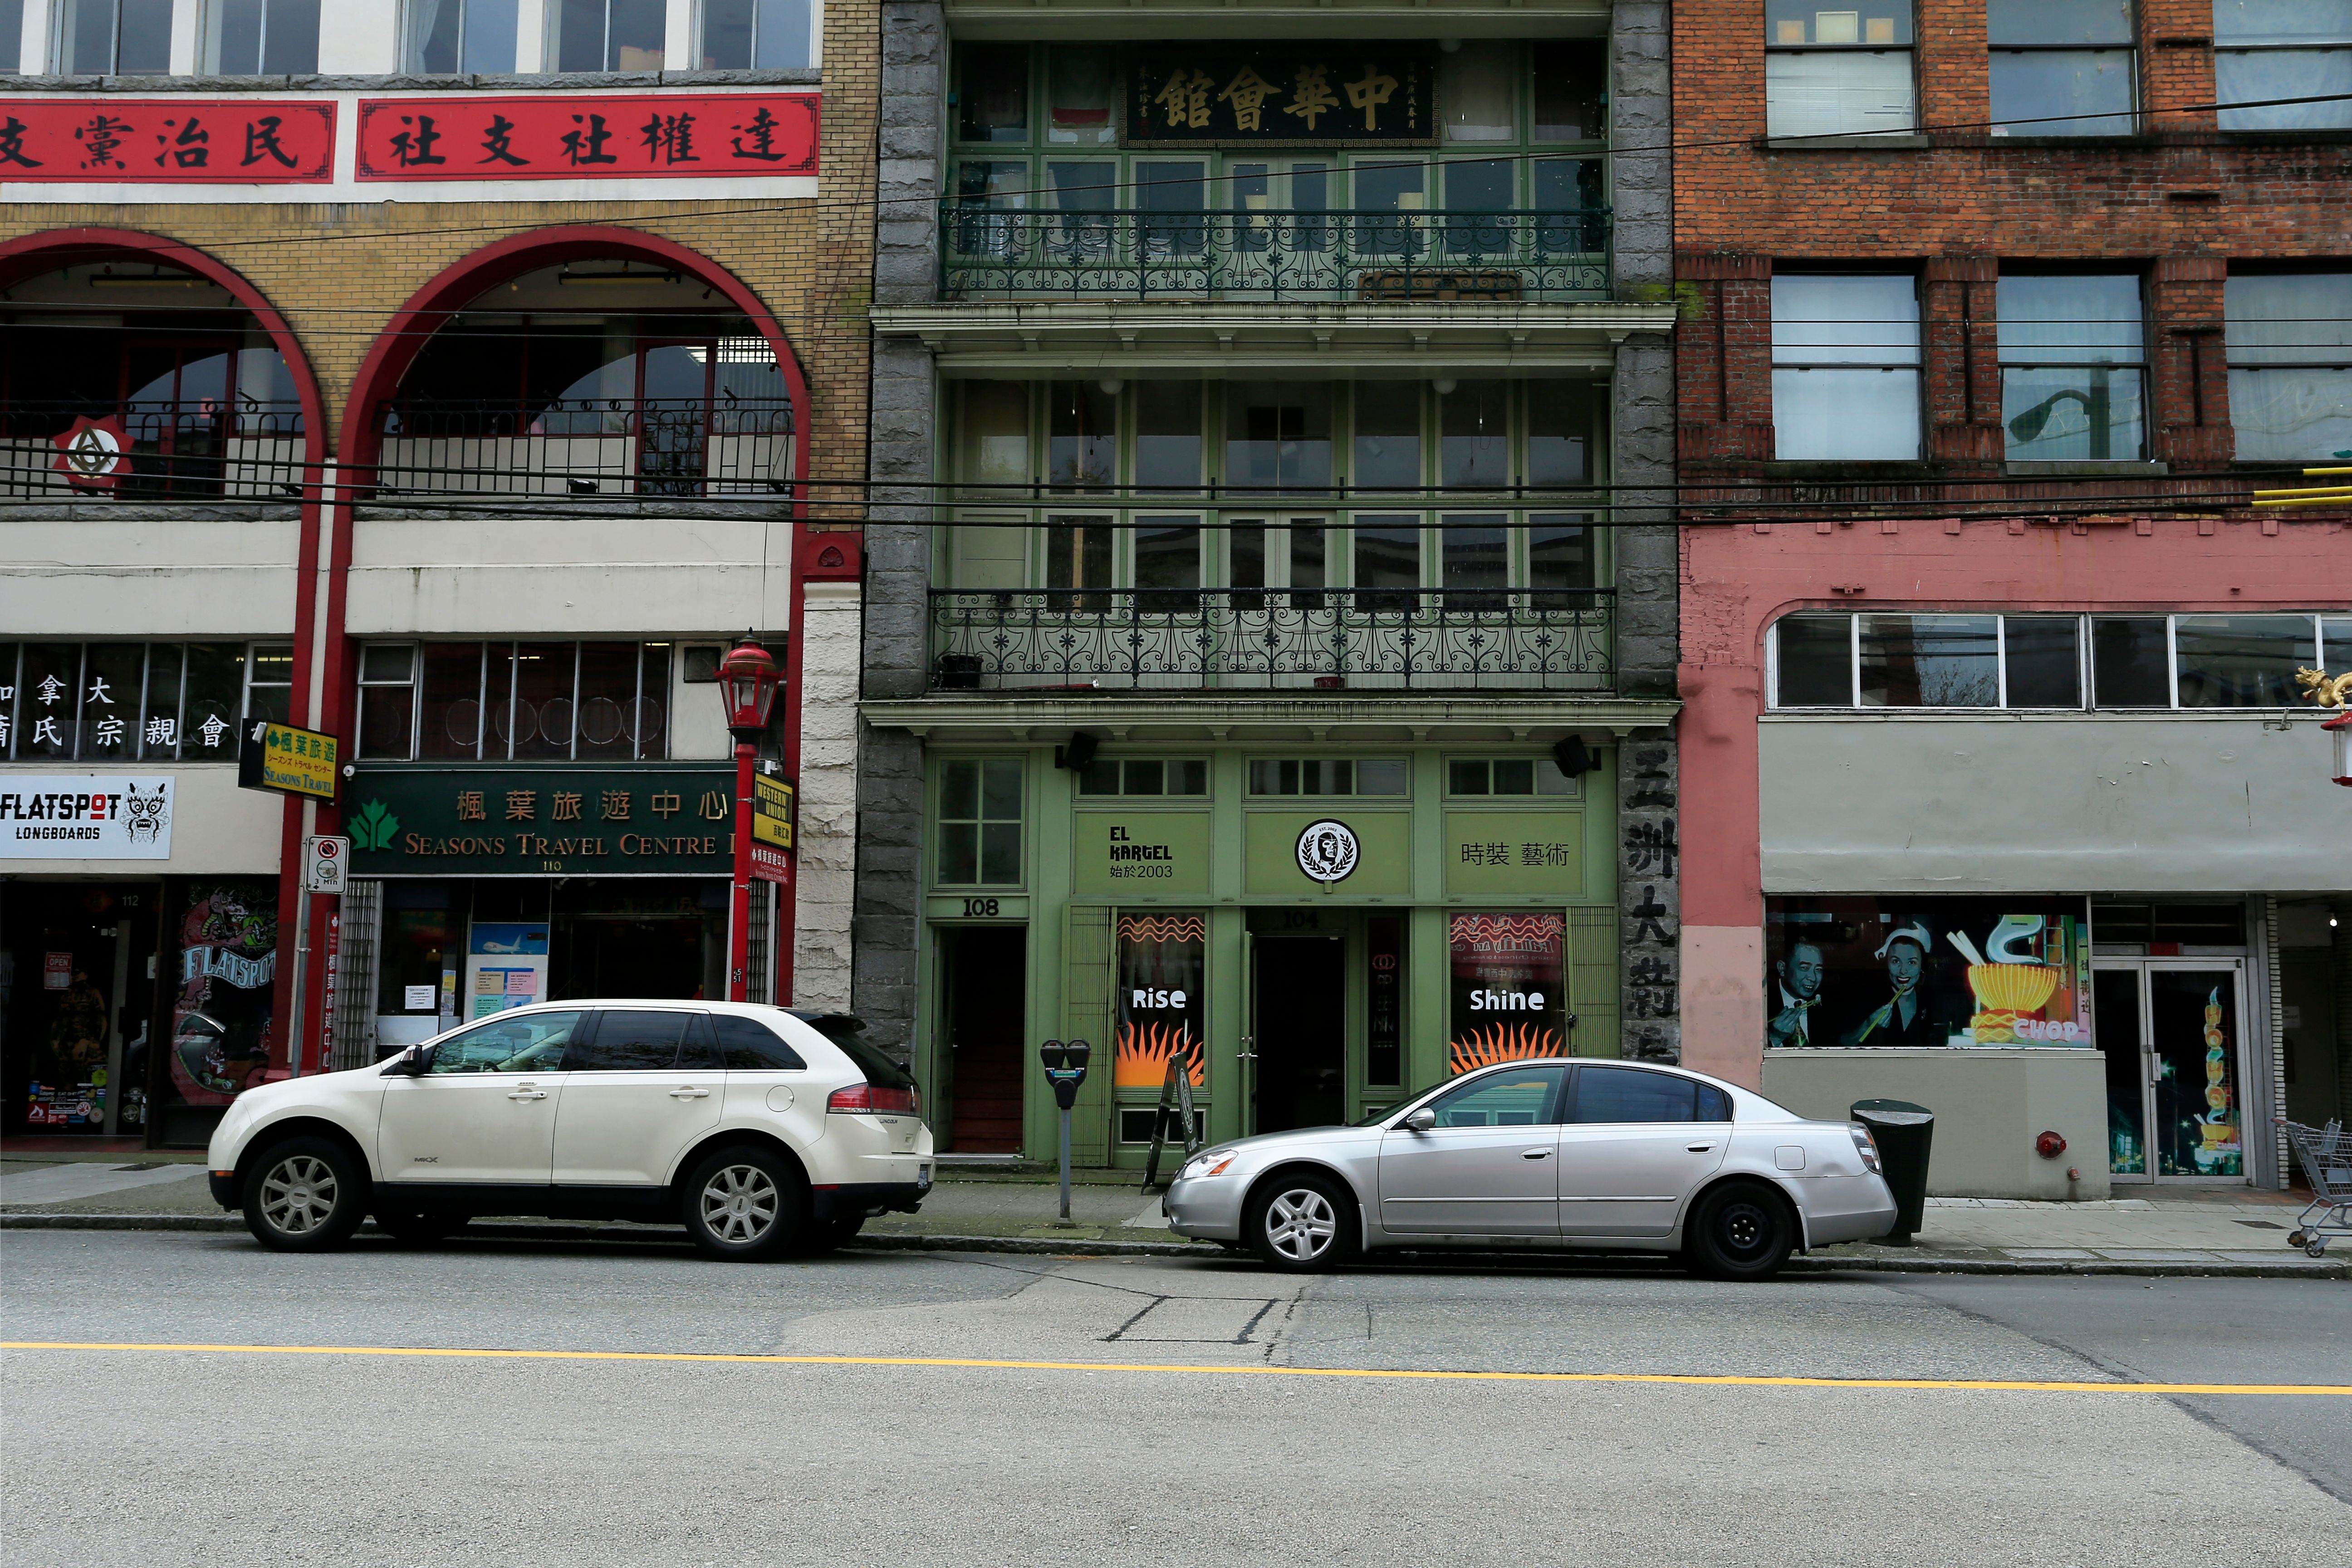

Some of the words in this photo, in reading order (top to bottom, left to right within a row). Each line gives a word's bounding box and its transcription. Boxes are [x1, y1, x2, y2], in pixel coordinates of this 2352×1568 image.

[264, 766, 301, 787] SEASONS
[303, 774, 333, 793] TRAVEL
[757, 783, 786, 806] WESTERN
[0, 794, 121, 820] FLATSPOT
[458, 790, 727, 820] 楓葉旅遊中心
[766, 801, 786, 821] UNION
[16, 828, 100, 840] LONGBOARDS
[1109, 826, 1130, 841] EL
[406, 833, 505, 855] SEASONS
[516, 833, 609, 856] TRAVEL
[620, 833, 716, 855] CENTRE
[543, 861, 561, 872] 110
[122, 896, 138, 906] 112
[963, 898, 999, 916] 108
[1284, 911, 1319, 929] 104
[49, 958, 69, 966] OPEN
[1470, 990, 1544, 1010] Shine
[2013, 1018, 2079, 1042] CHOP
